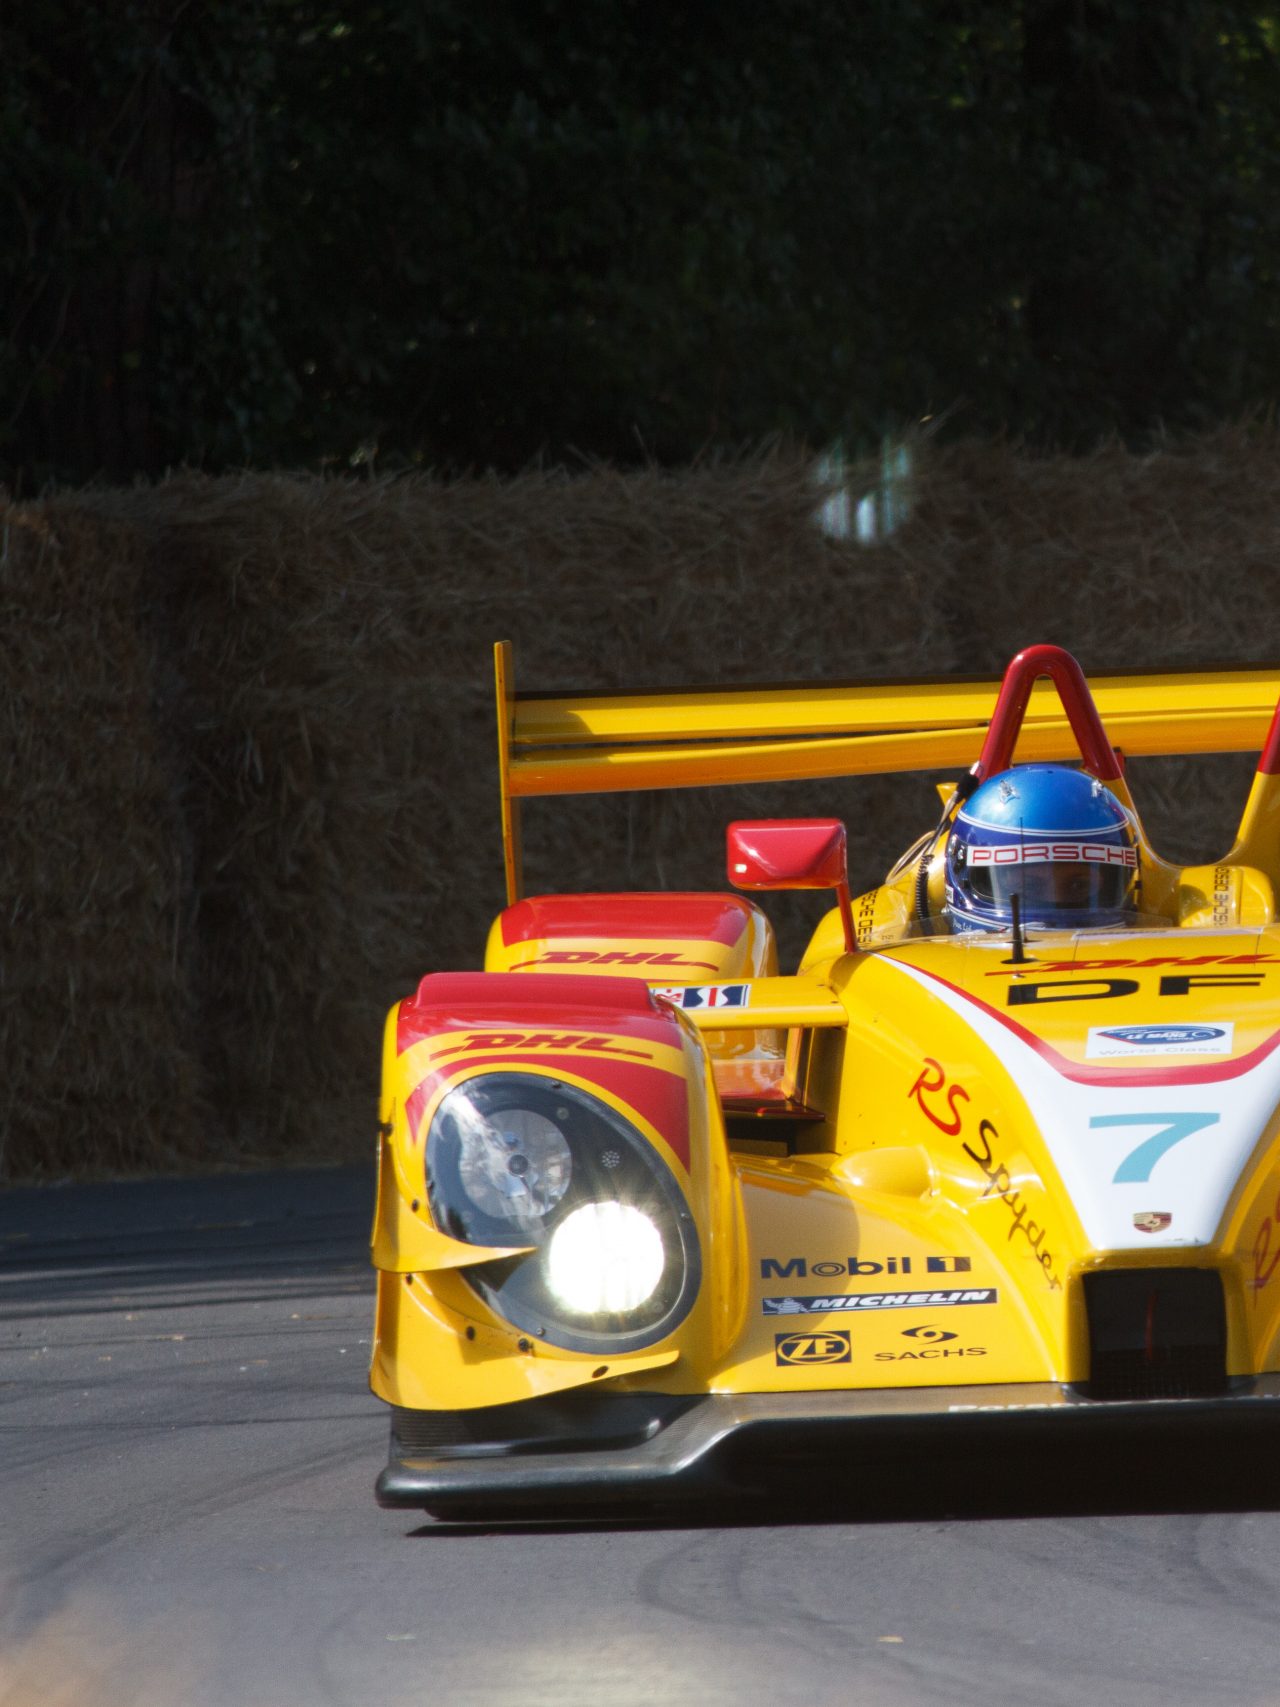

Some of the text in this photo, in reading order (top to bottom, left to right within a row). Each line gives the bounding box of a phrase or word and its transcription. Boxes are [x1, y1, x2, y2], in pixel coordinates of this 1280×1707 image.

[972, 845, 1137, 866] PORSCHE
[538, 951, 698, 966] DHL
[460, 1034, 630, 1053] DHL
[1089, 1112, 1221, 1184] 7
[908, 1058, 1063, 1291] RS Spyder
[760, 1256, 911, 1279] Mobil
[810, 1290, 991, 1310] MICHELIN
[783, 1338, 837, 1359] ZF
[873, 1347, 988, 1362] SACHS
